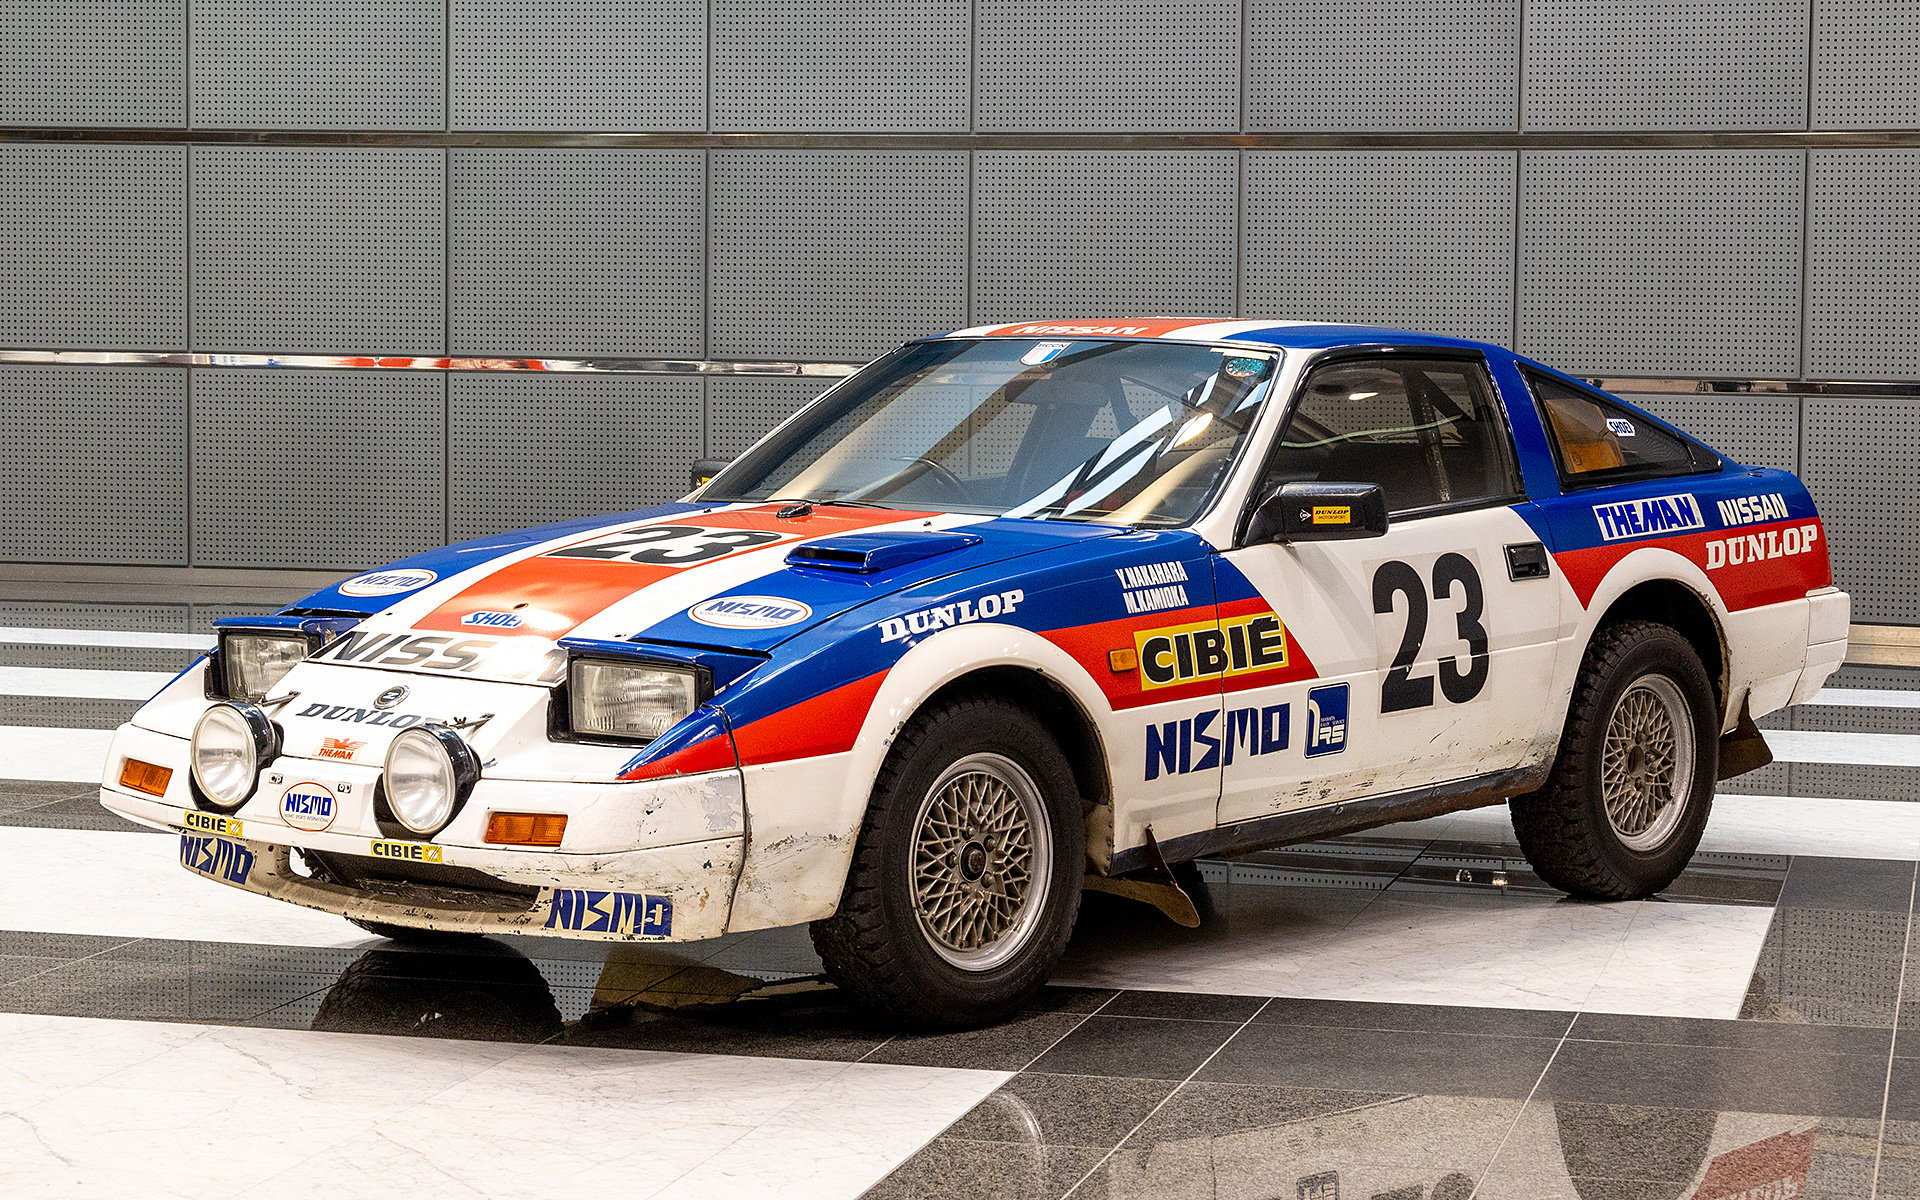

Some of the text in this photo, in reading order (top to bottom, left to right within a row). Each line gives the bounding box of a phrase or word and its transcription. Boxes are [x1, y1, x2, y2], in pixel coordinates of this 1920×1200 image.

[1011, 325, 1149, 335] NISSAN
[1716, 493, 1789, 527] NISSAN
[545, 526, 782, 564] 23
[1705, 524, 1818, 570] DUNLOP
[355, 575, 428, 587] NISMO
[1122, 584, 1189, 614] M.KAMIOKA
[704, 601, 802, 620] NISMO
[878, 589, 1024, 643] DUNLOP
[1142, 615, 1285, 684] CIBIÉ
[1372, 552, 1490, 714] 23
[296, 703, 443, 729] DUNLO
[1144, 702, 1291, 781] NISMO
[285, 793, 332, 816] NISMO
[180, 835, 253, 885] NISMO
[544, 888, 673, 937] NISMO
